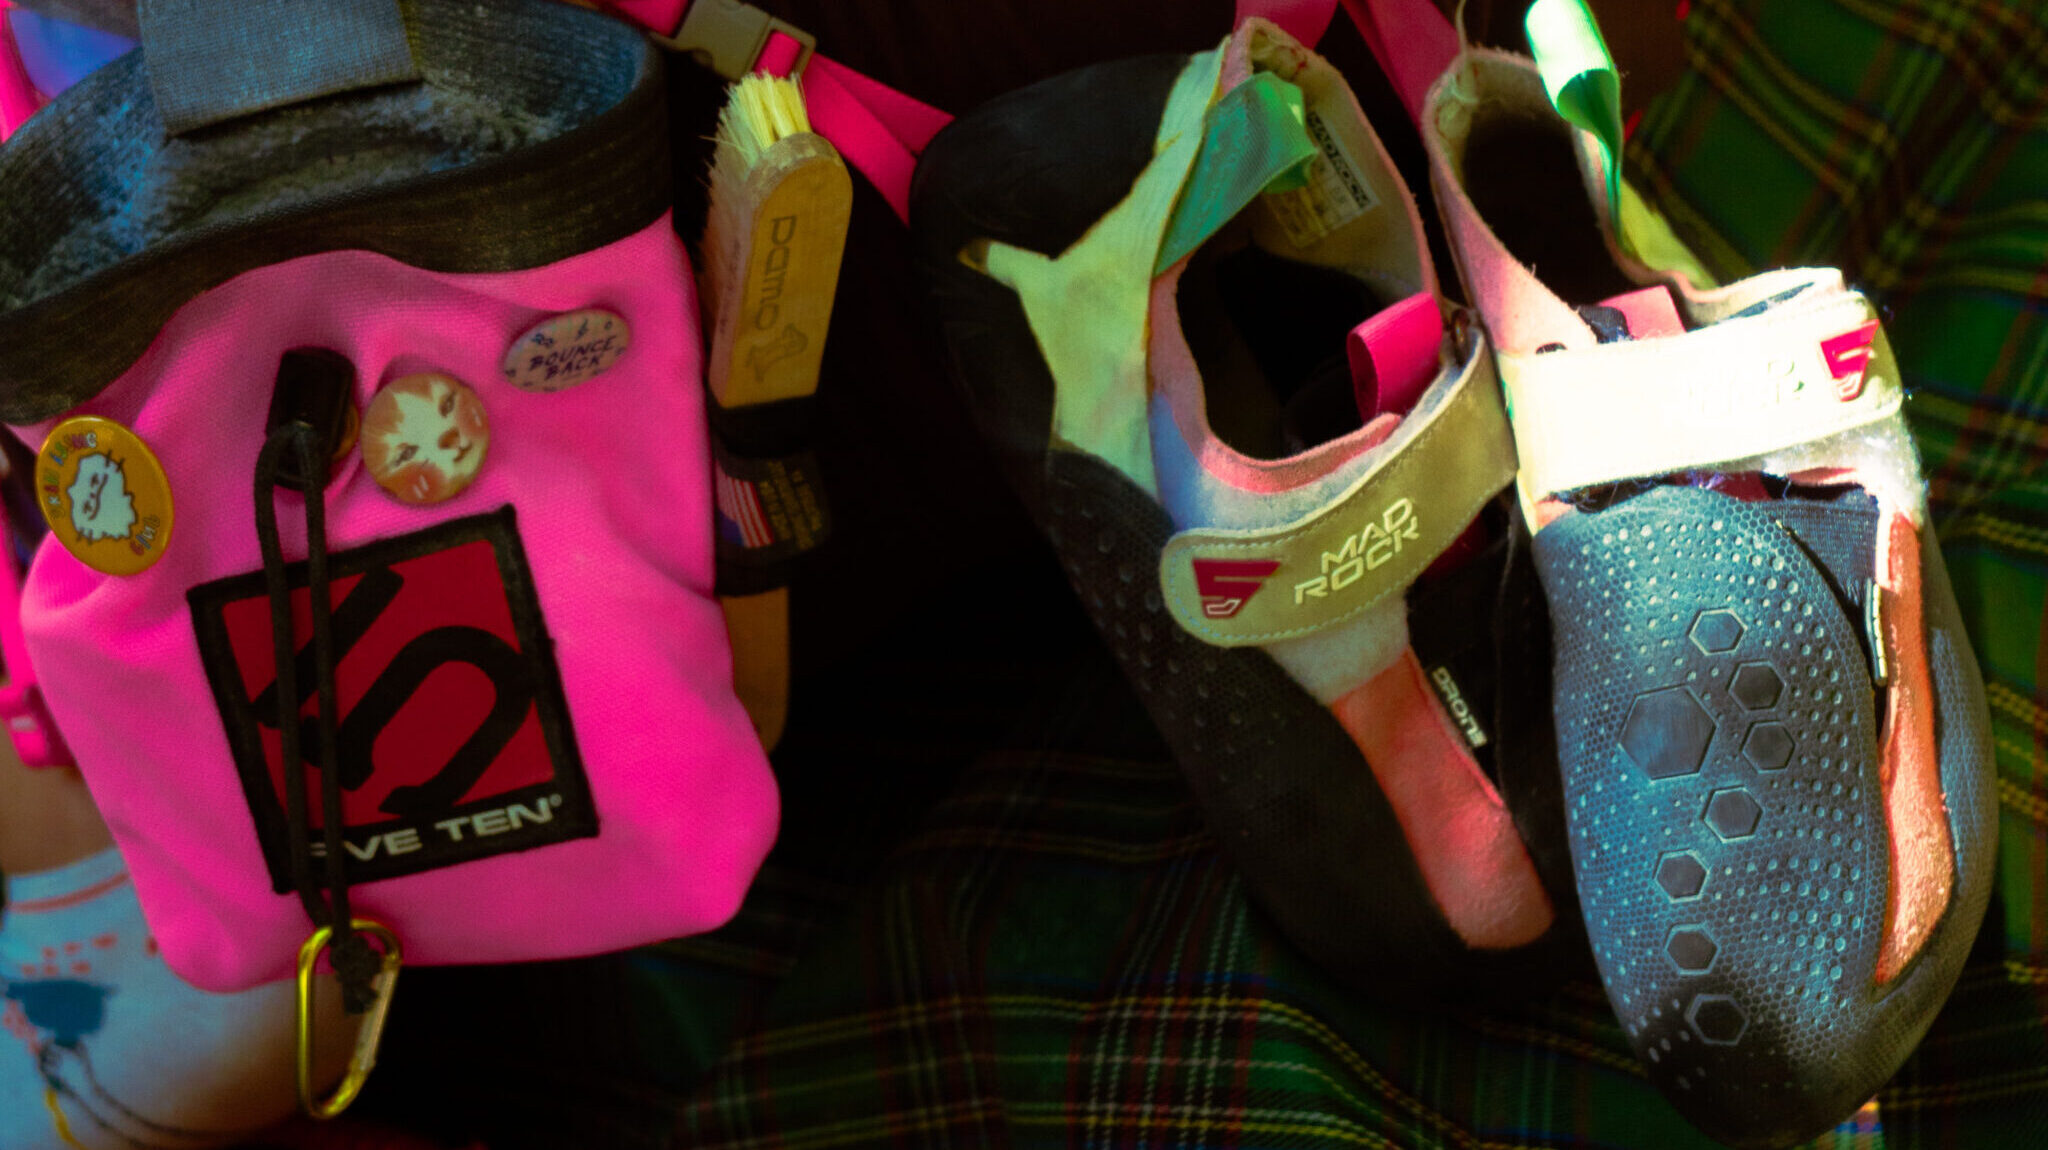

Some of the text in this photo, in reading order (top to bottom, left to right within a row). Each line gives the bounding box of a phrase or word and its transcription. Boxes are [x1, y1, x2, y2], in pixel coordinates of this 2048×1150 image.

[528, 334, 617, 372] BOUNCE
[544, 355, 603, 380] BACK
[1294, 515, 1420, 605] ROCK
[1321, 497, 1413, 573] MAD
[1432, 666, 1487, 748] DRONE
